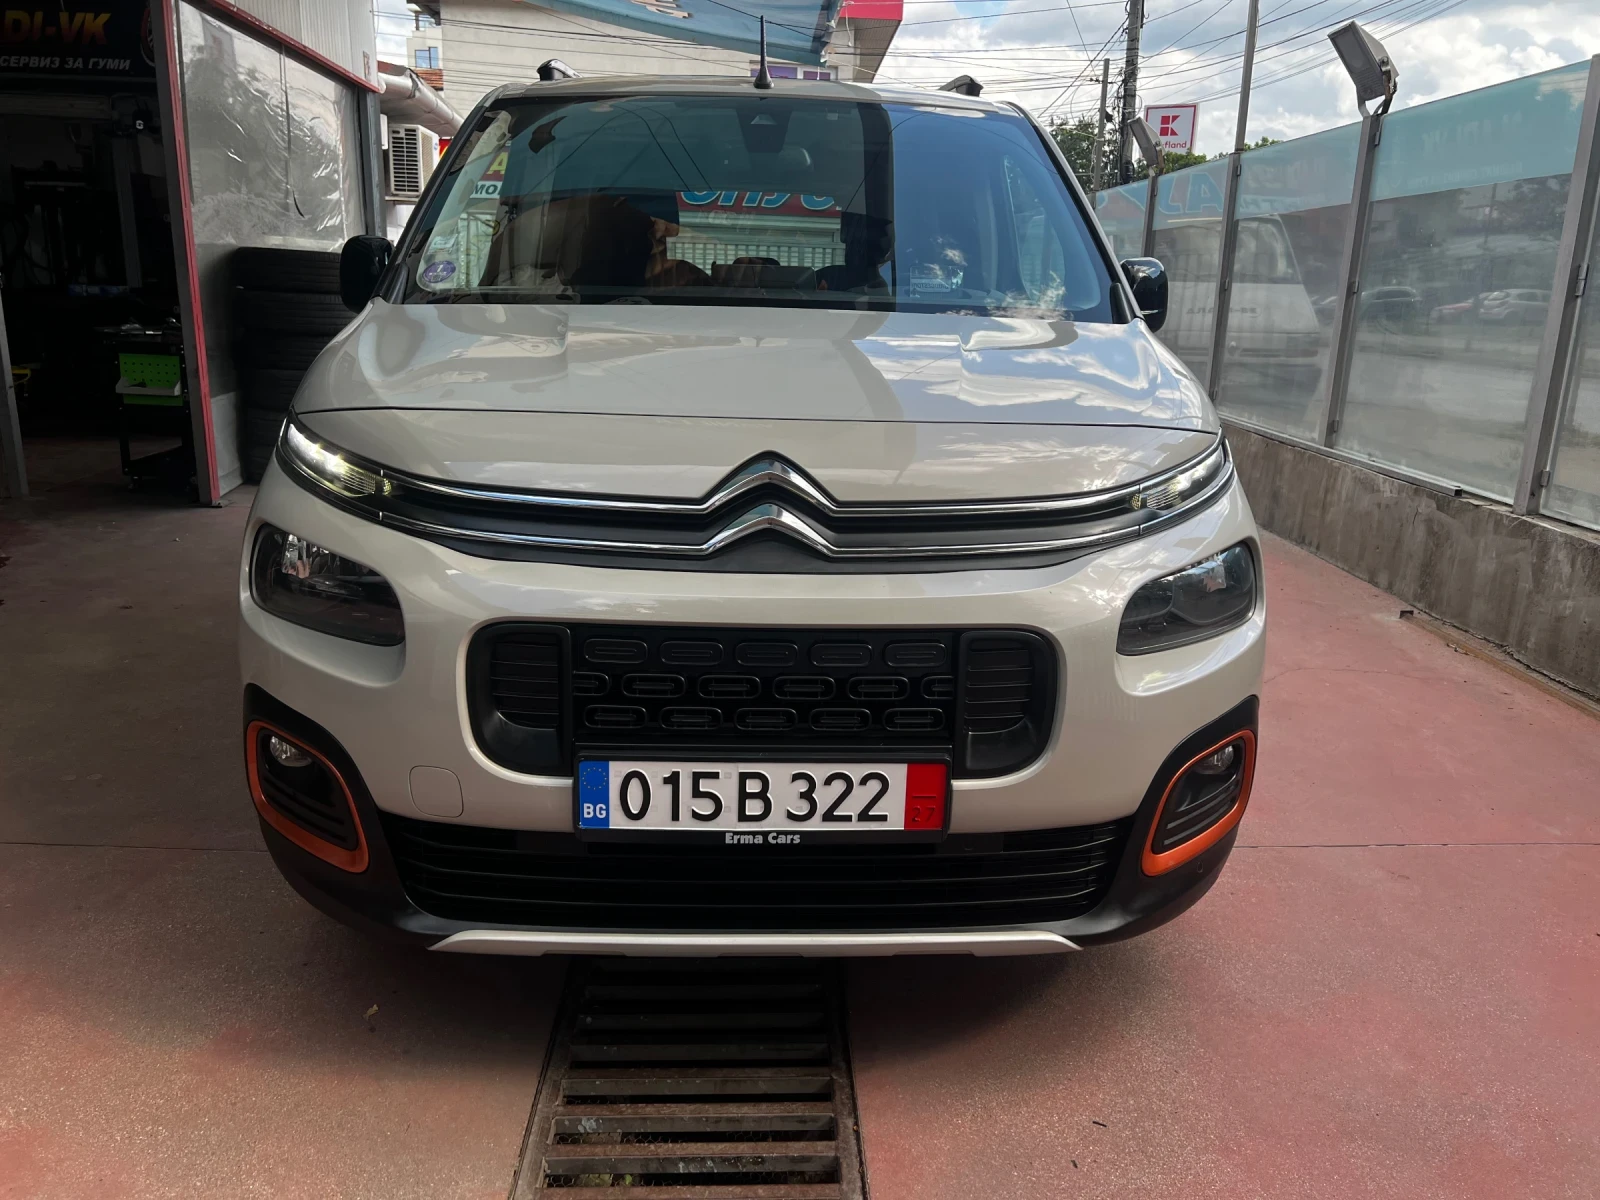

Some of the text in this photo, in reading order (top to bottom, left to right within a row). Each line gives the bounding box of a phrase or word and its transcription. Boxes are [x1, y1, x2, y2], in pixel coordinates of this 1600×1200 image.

[4, 9, 112, 45] DI-VK
[0, 55, 131, 70] СЕРВИЗ ЗА ГУМИ
[1163, 141, 1187, 149] fland
[583, 803, 607, 819] BG
[725, 832, 801, 844] Erma Cars
